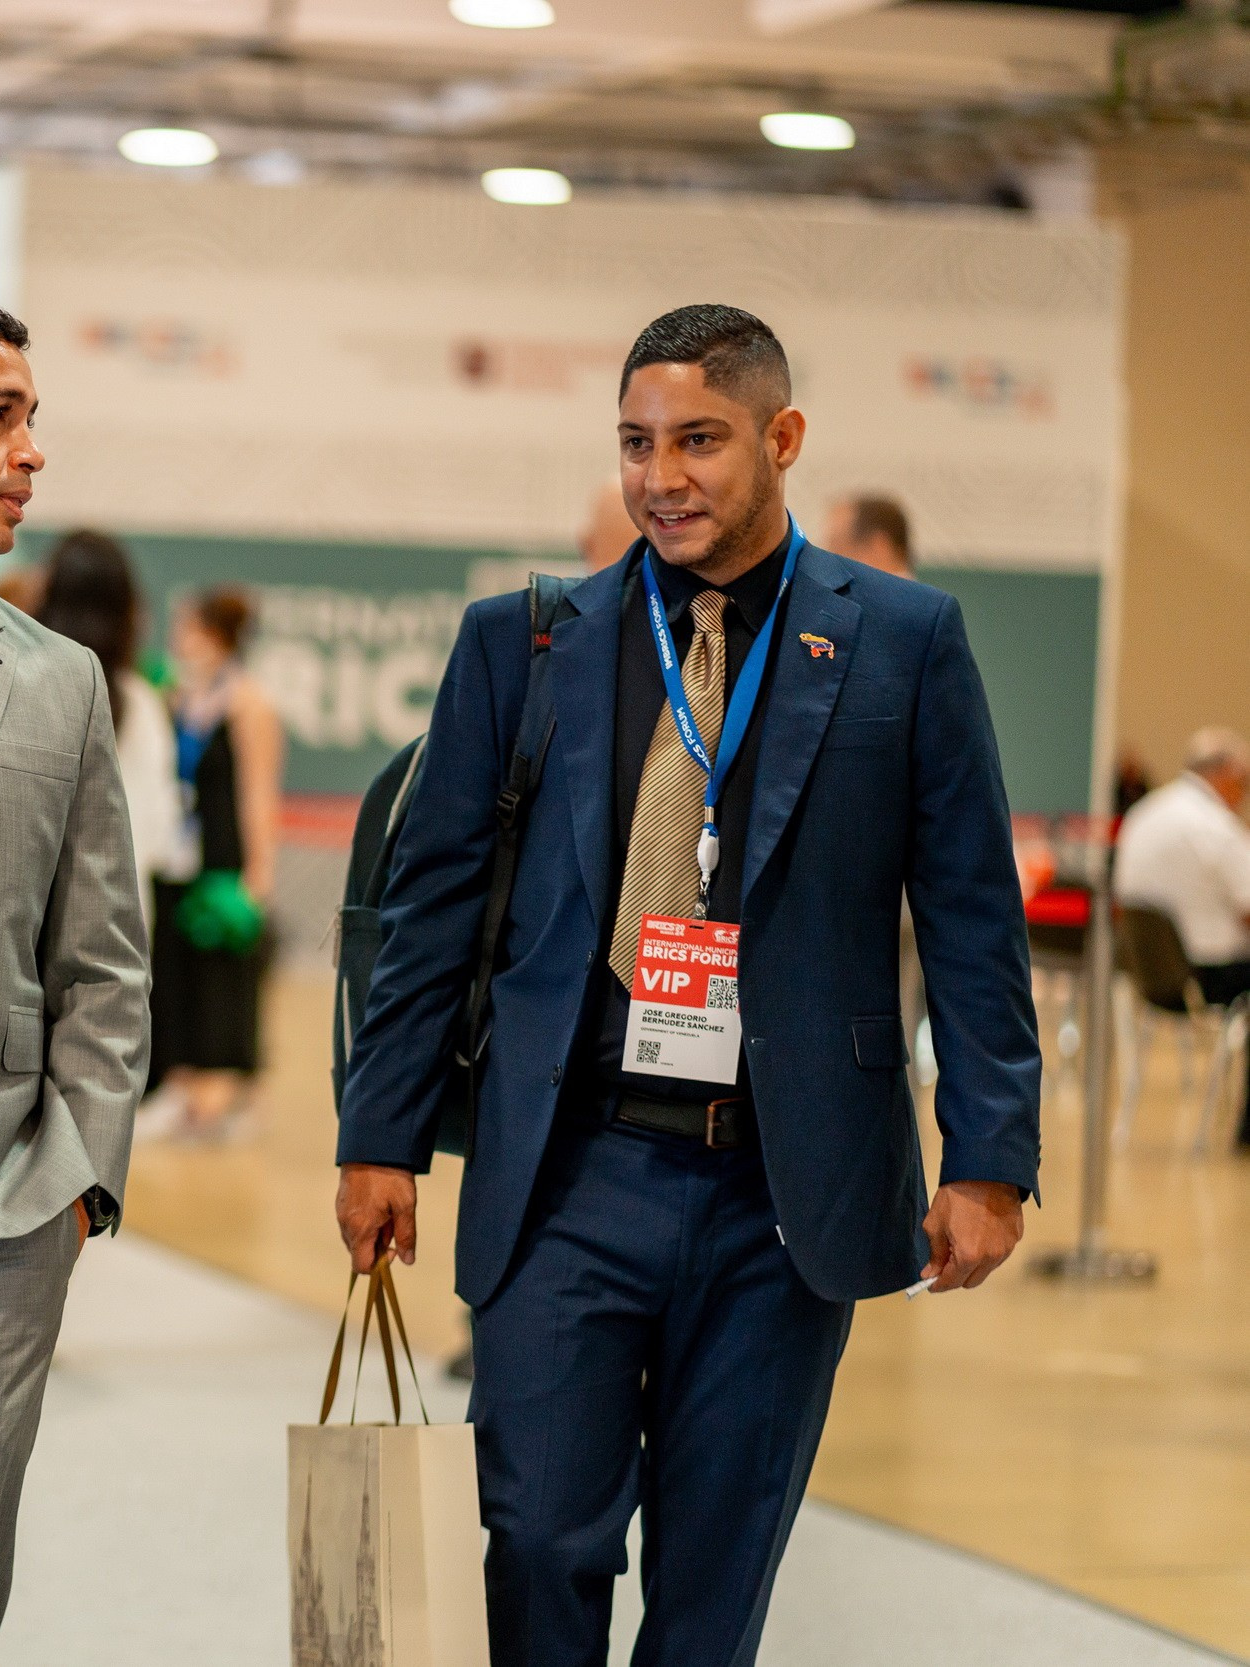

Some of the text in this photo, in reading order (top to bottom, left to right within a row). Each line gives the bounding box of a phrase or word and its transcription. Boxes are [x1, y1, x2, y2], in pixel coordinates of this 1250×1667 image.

[650, 592, 664, 630] FORUM
[675, 706, 697, 746] FORUM
[642, 945, 687, 962] BRICS
[643, 938, 738, 956] INTERNATIONAL MUNICIP
[640, 966, 691, 994] VIP
[641, 1016, 725, 1033] BERMUDEZ SANCHEZ
[642, 1008, 708, 1023] JOSE GREGORIO
